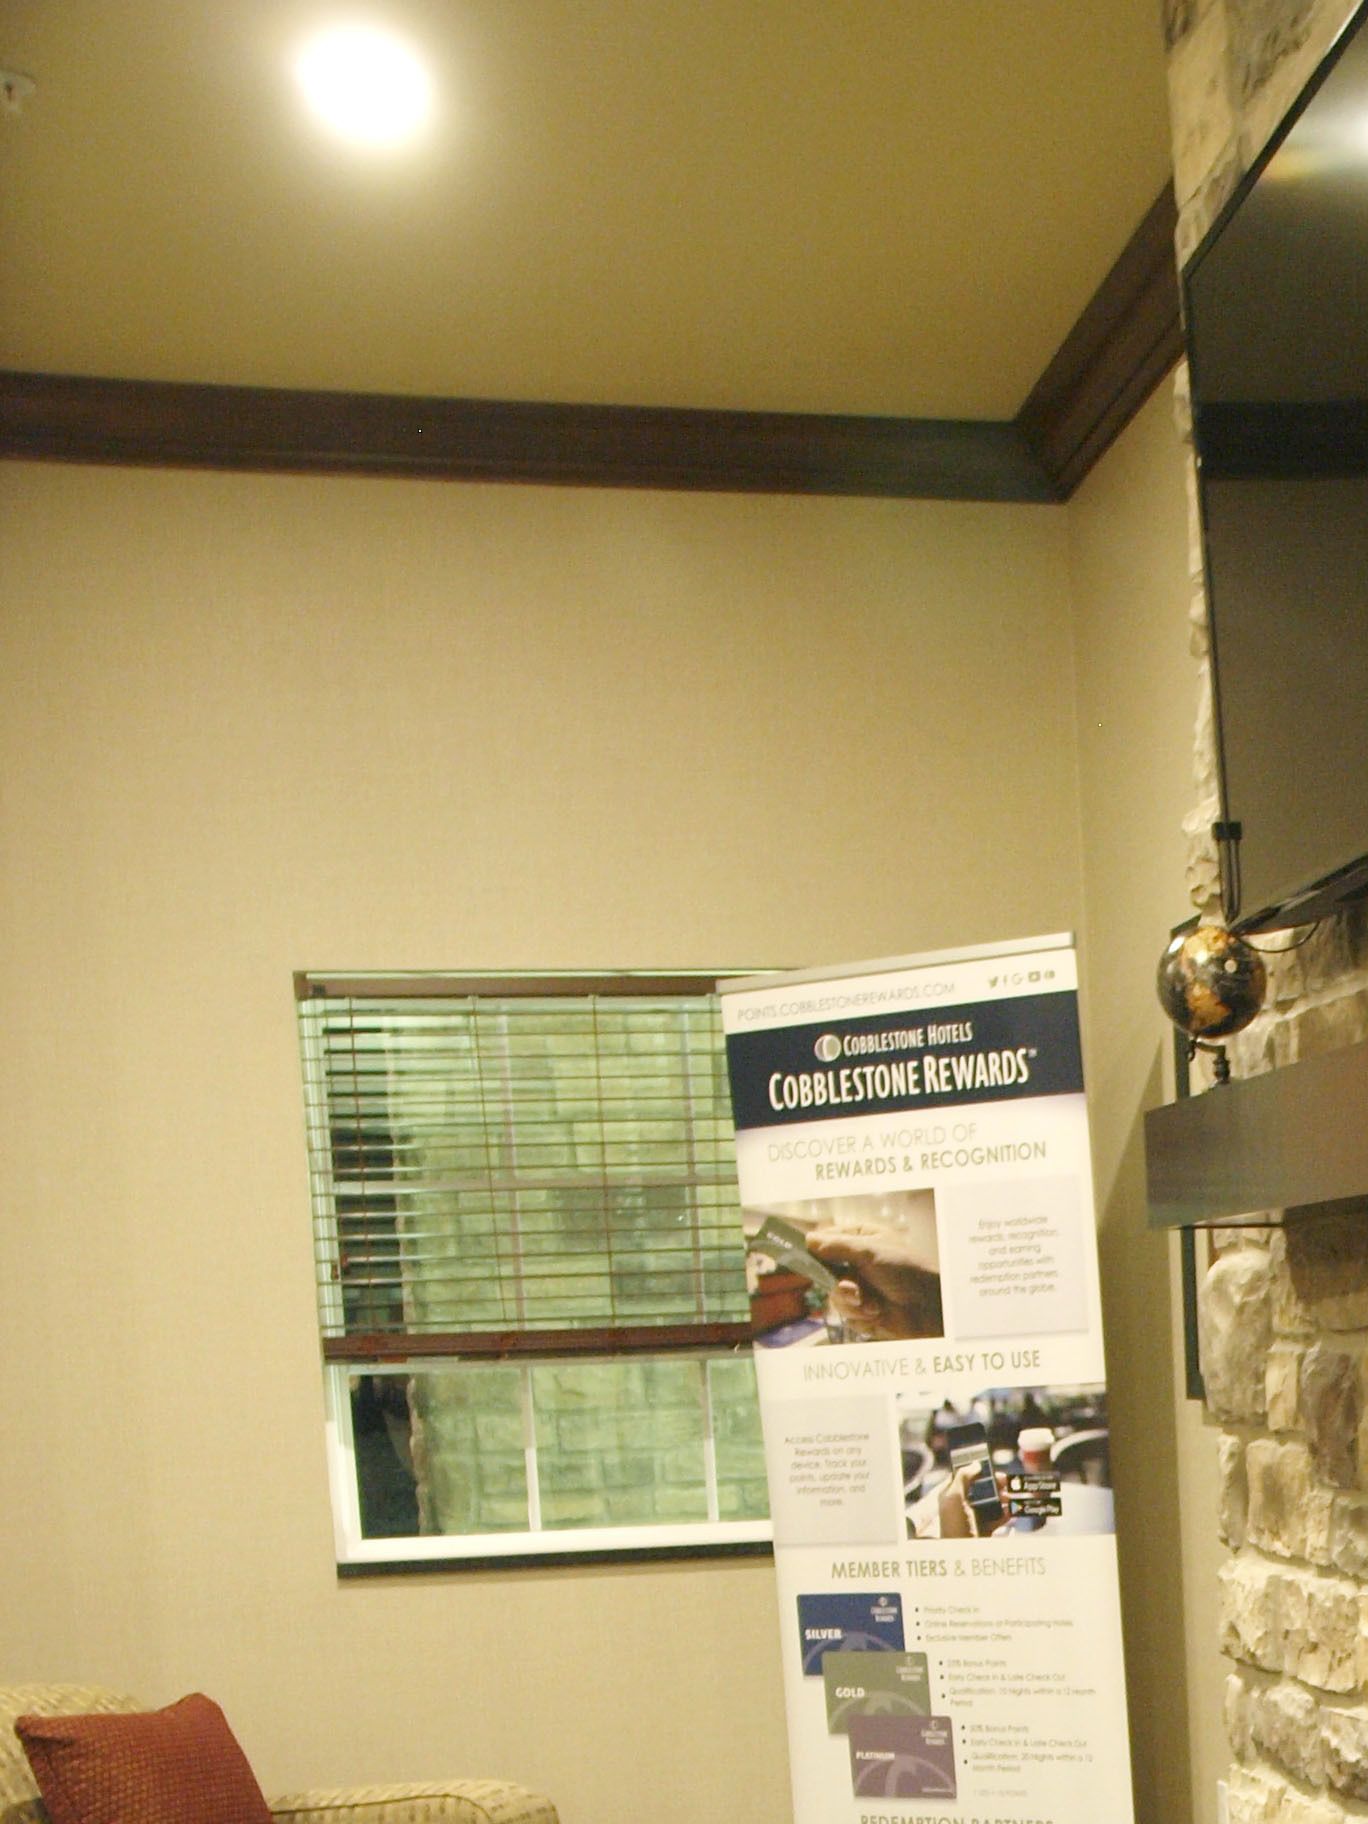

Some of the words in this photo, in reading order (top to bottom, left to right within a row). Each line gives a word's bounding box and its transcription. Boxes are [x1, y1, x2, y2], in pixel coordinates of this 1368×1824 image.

[843, 1028, 924, 1056] COBBLESTONE
[928, 1022, 973, 1046] HOTELS
[768, 1064, 920, 1111] COBBLESTONE
[923, 1048, 1029, 1094] REWARDS
[768, 1136, 855, 1162] DISCOVER
[863, 1135, 873, 1150] A
[882, 1125, 947, 1148] WORLD
[953, 1122, 977, 1141] OF
[815, 1157, 897, 1181] REWARDS
[902, 1155, 913, 1172] &
[920, 1141, 1046, 1170] RECOGNITION
[803, 1358, 908, 1383] INNOVATIVE
[915, 1358, 927, 1376] &
[933, 1355, 976, 1375] EASY
[980, 1352, 1003, 1371] TO
[1011, 1350, 1040, 1369] USE
[831, 1560, 900, 1579] MEMBER
[907, 1559, 948, 1577] TIERS
[954, 1559, 965, 1575] &
[972, 1556, 1046, 1577] BENEFITS
[805, 1628, 842, 1641] SILVER
[835, 1687, 866, 1699] GOLD
